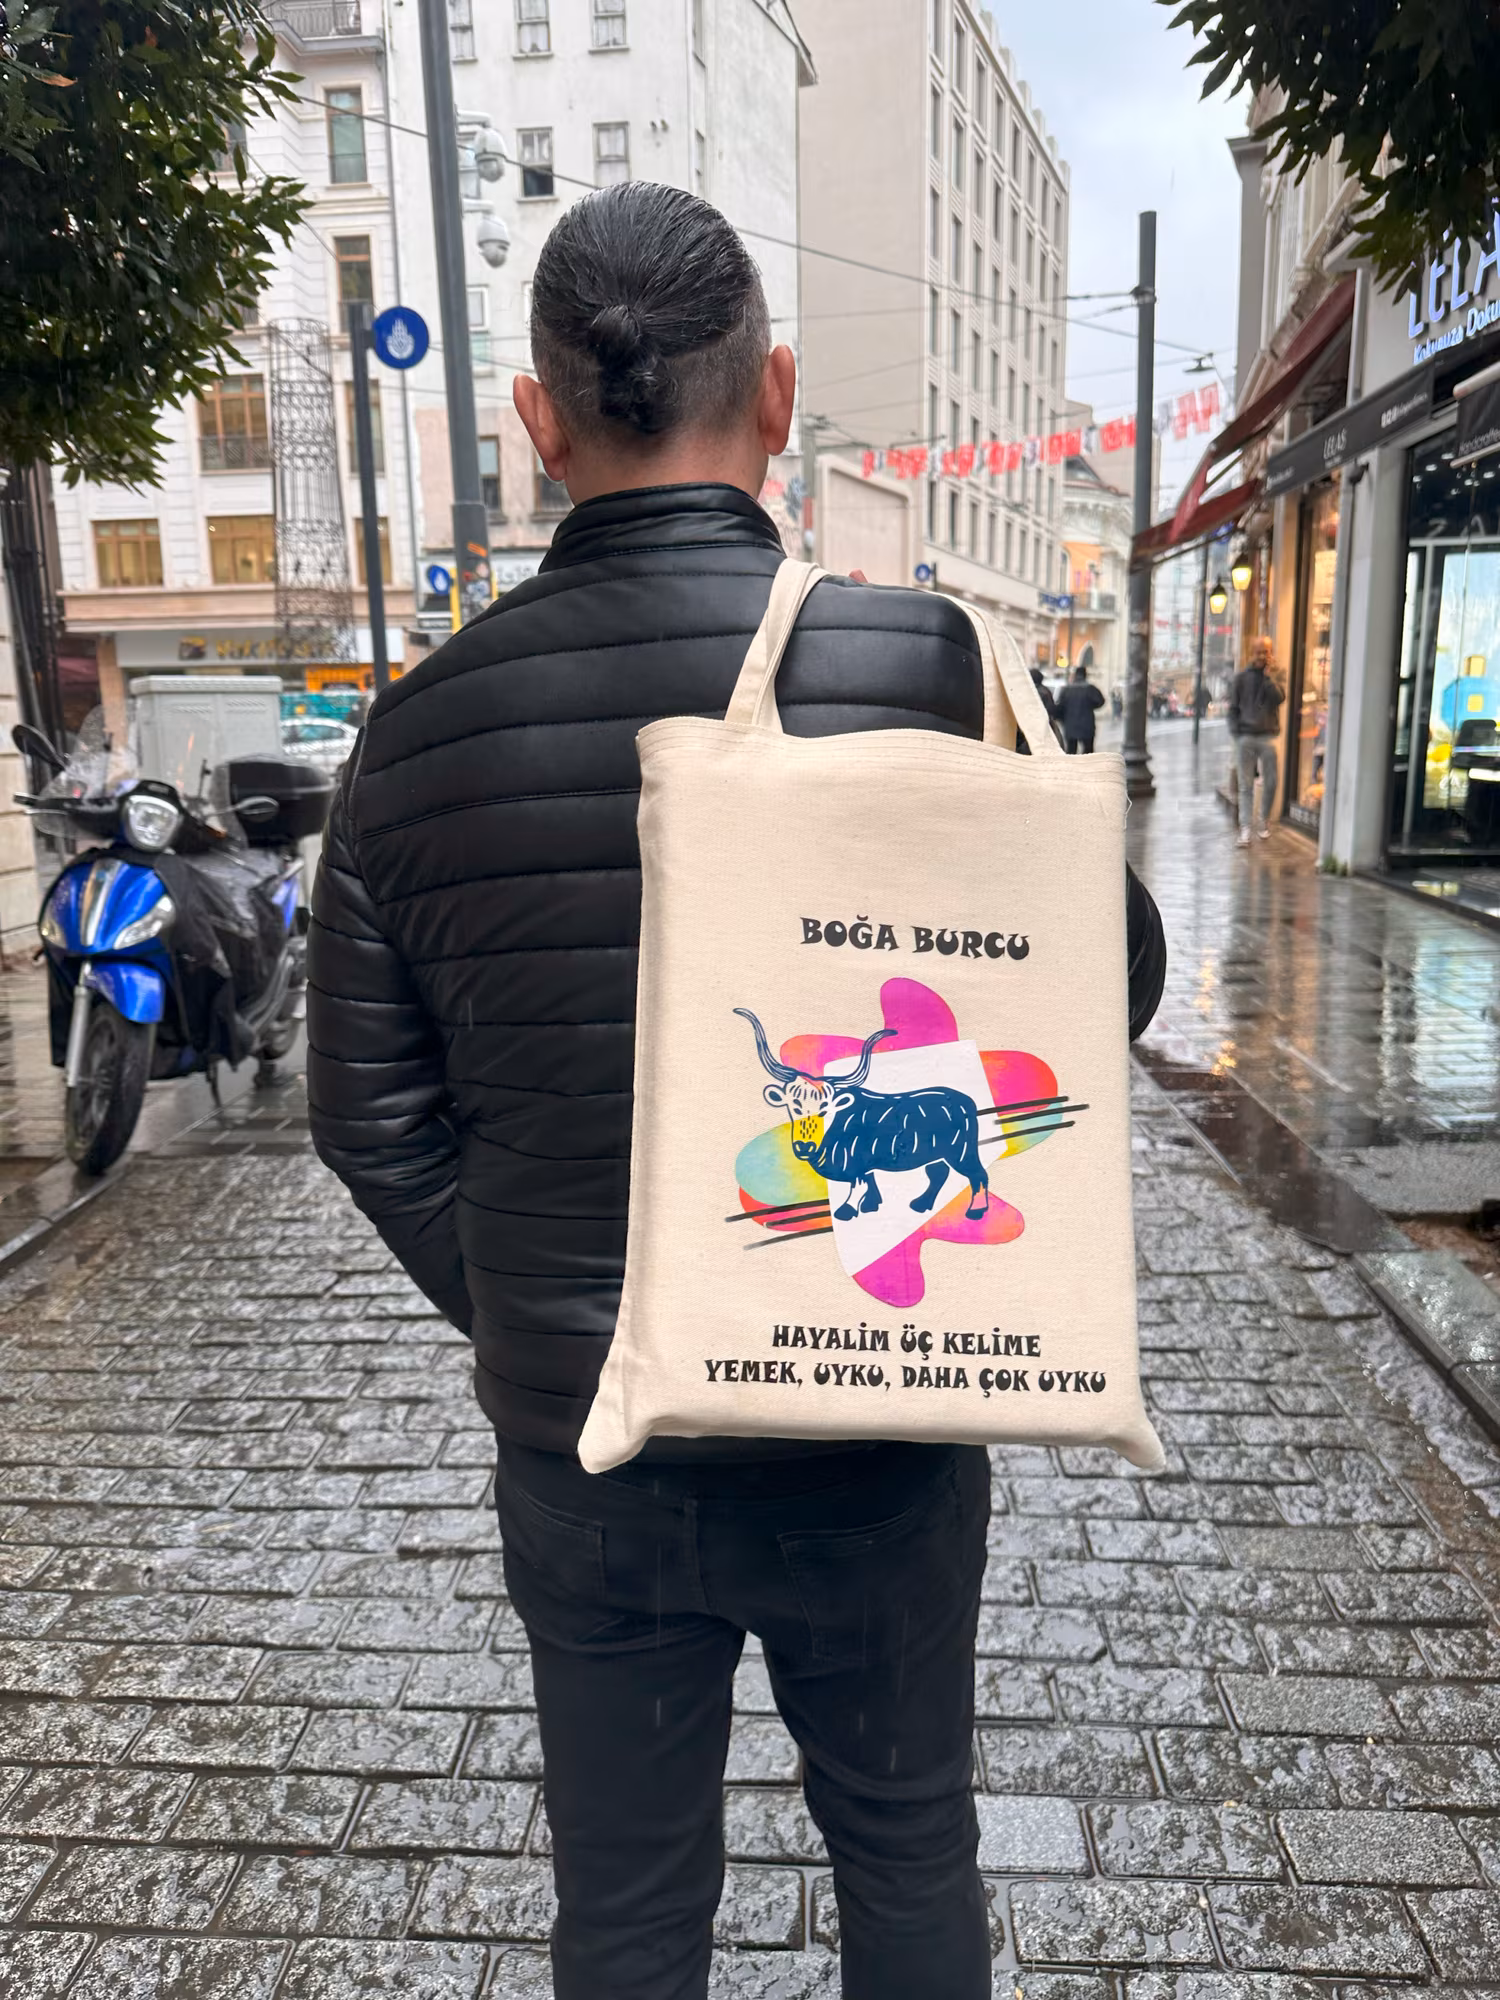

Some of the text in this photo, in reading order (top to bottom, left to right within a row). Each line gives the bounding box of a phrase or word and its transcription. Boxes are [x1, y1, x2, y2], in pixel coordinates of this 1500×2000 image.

[800, 914, 1030, 961] BOĞA BURCU
[772, 1322, 1041, 1360] HAYALİM ÜÇ KELİME
[704, 1359, 1106, 1398] YEMEK, UYKU, DAHA ÇOK UYKU
